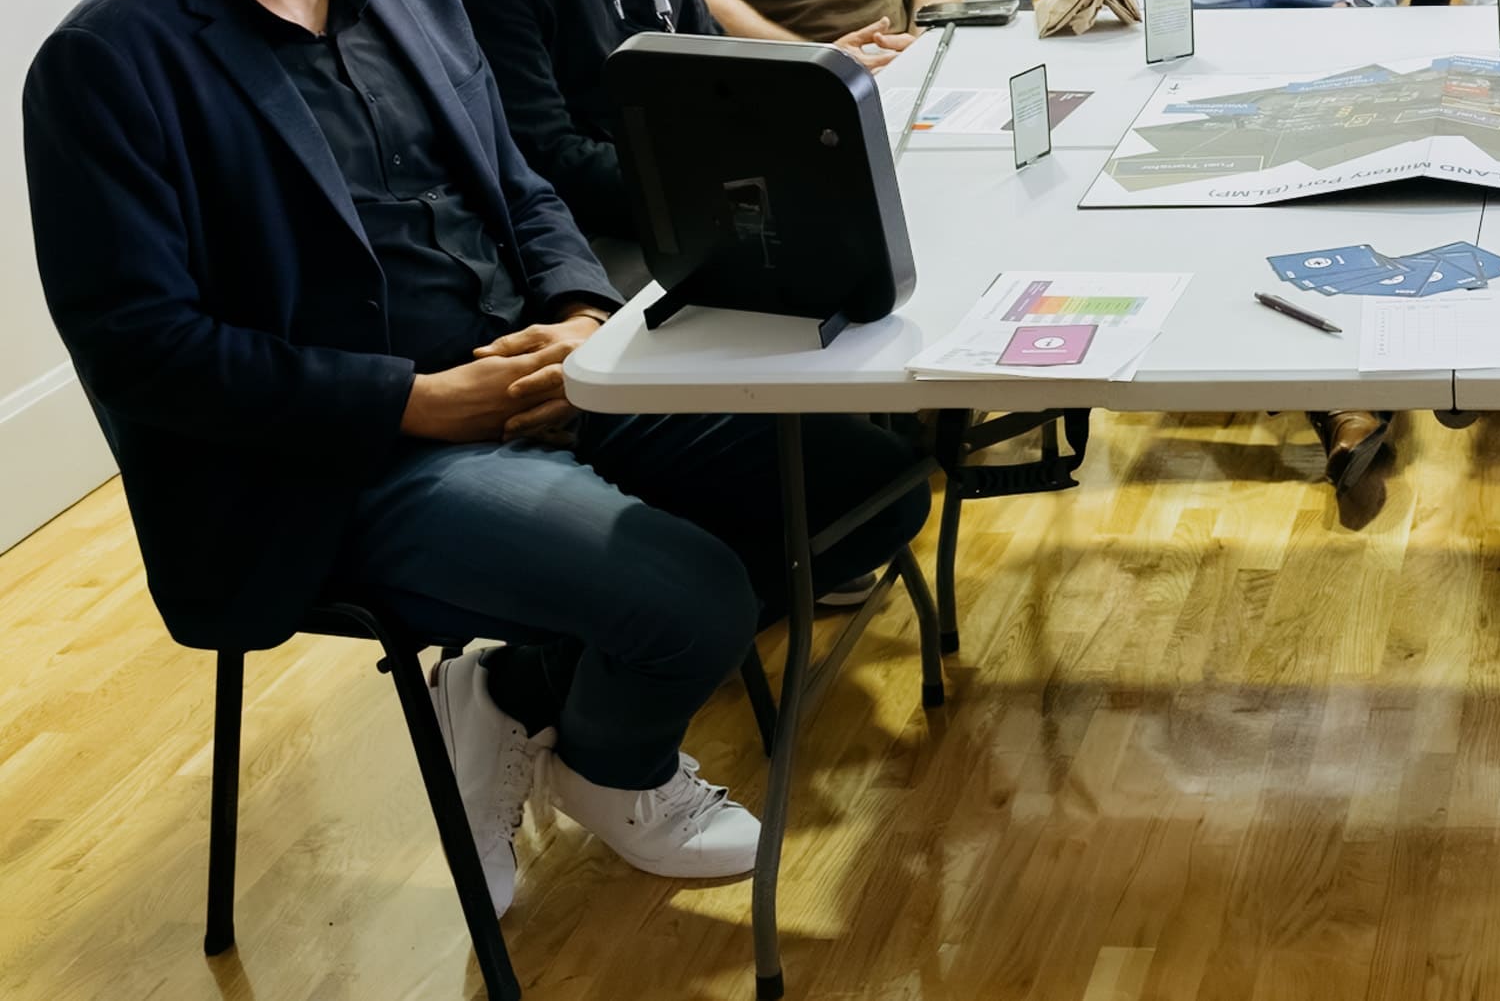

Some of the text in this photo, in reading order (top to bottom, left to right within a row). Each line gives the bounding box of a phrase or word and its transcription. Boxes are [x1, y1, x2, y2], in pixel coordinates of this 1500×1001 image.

[1350, 162, 1431, 179] Military
[1298, 176, 1342, 189] Port
[1208, 185, 1289, 198] (BLMP)
